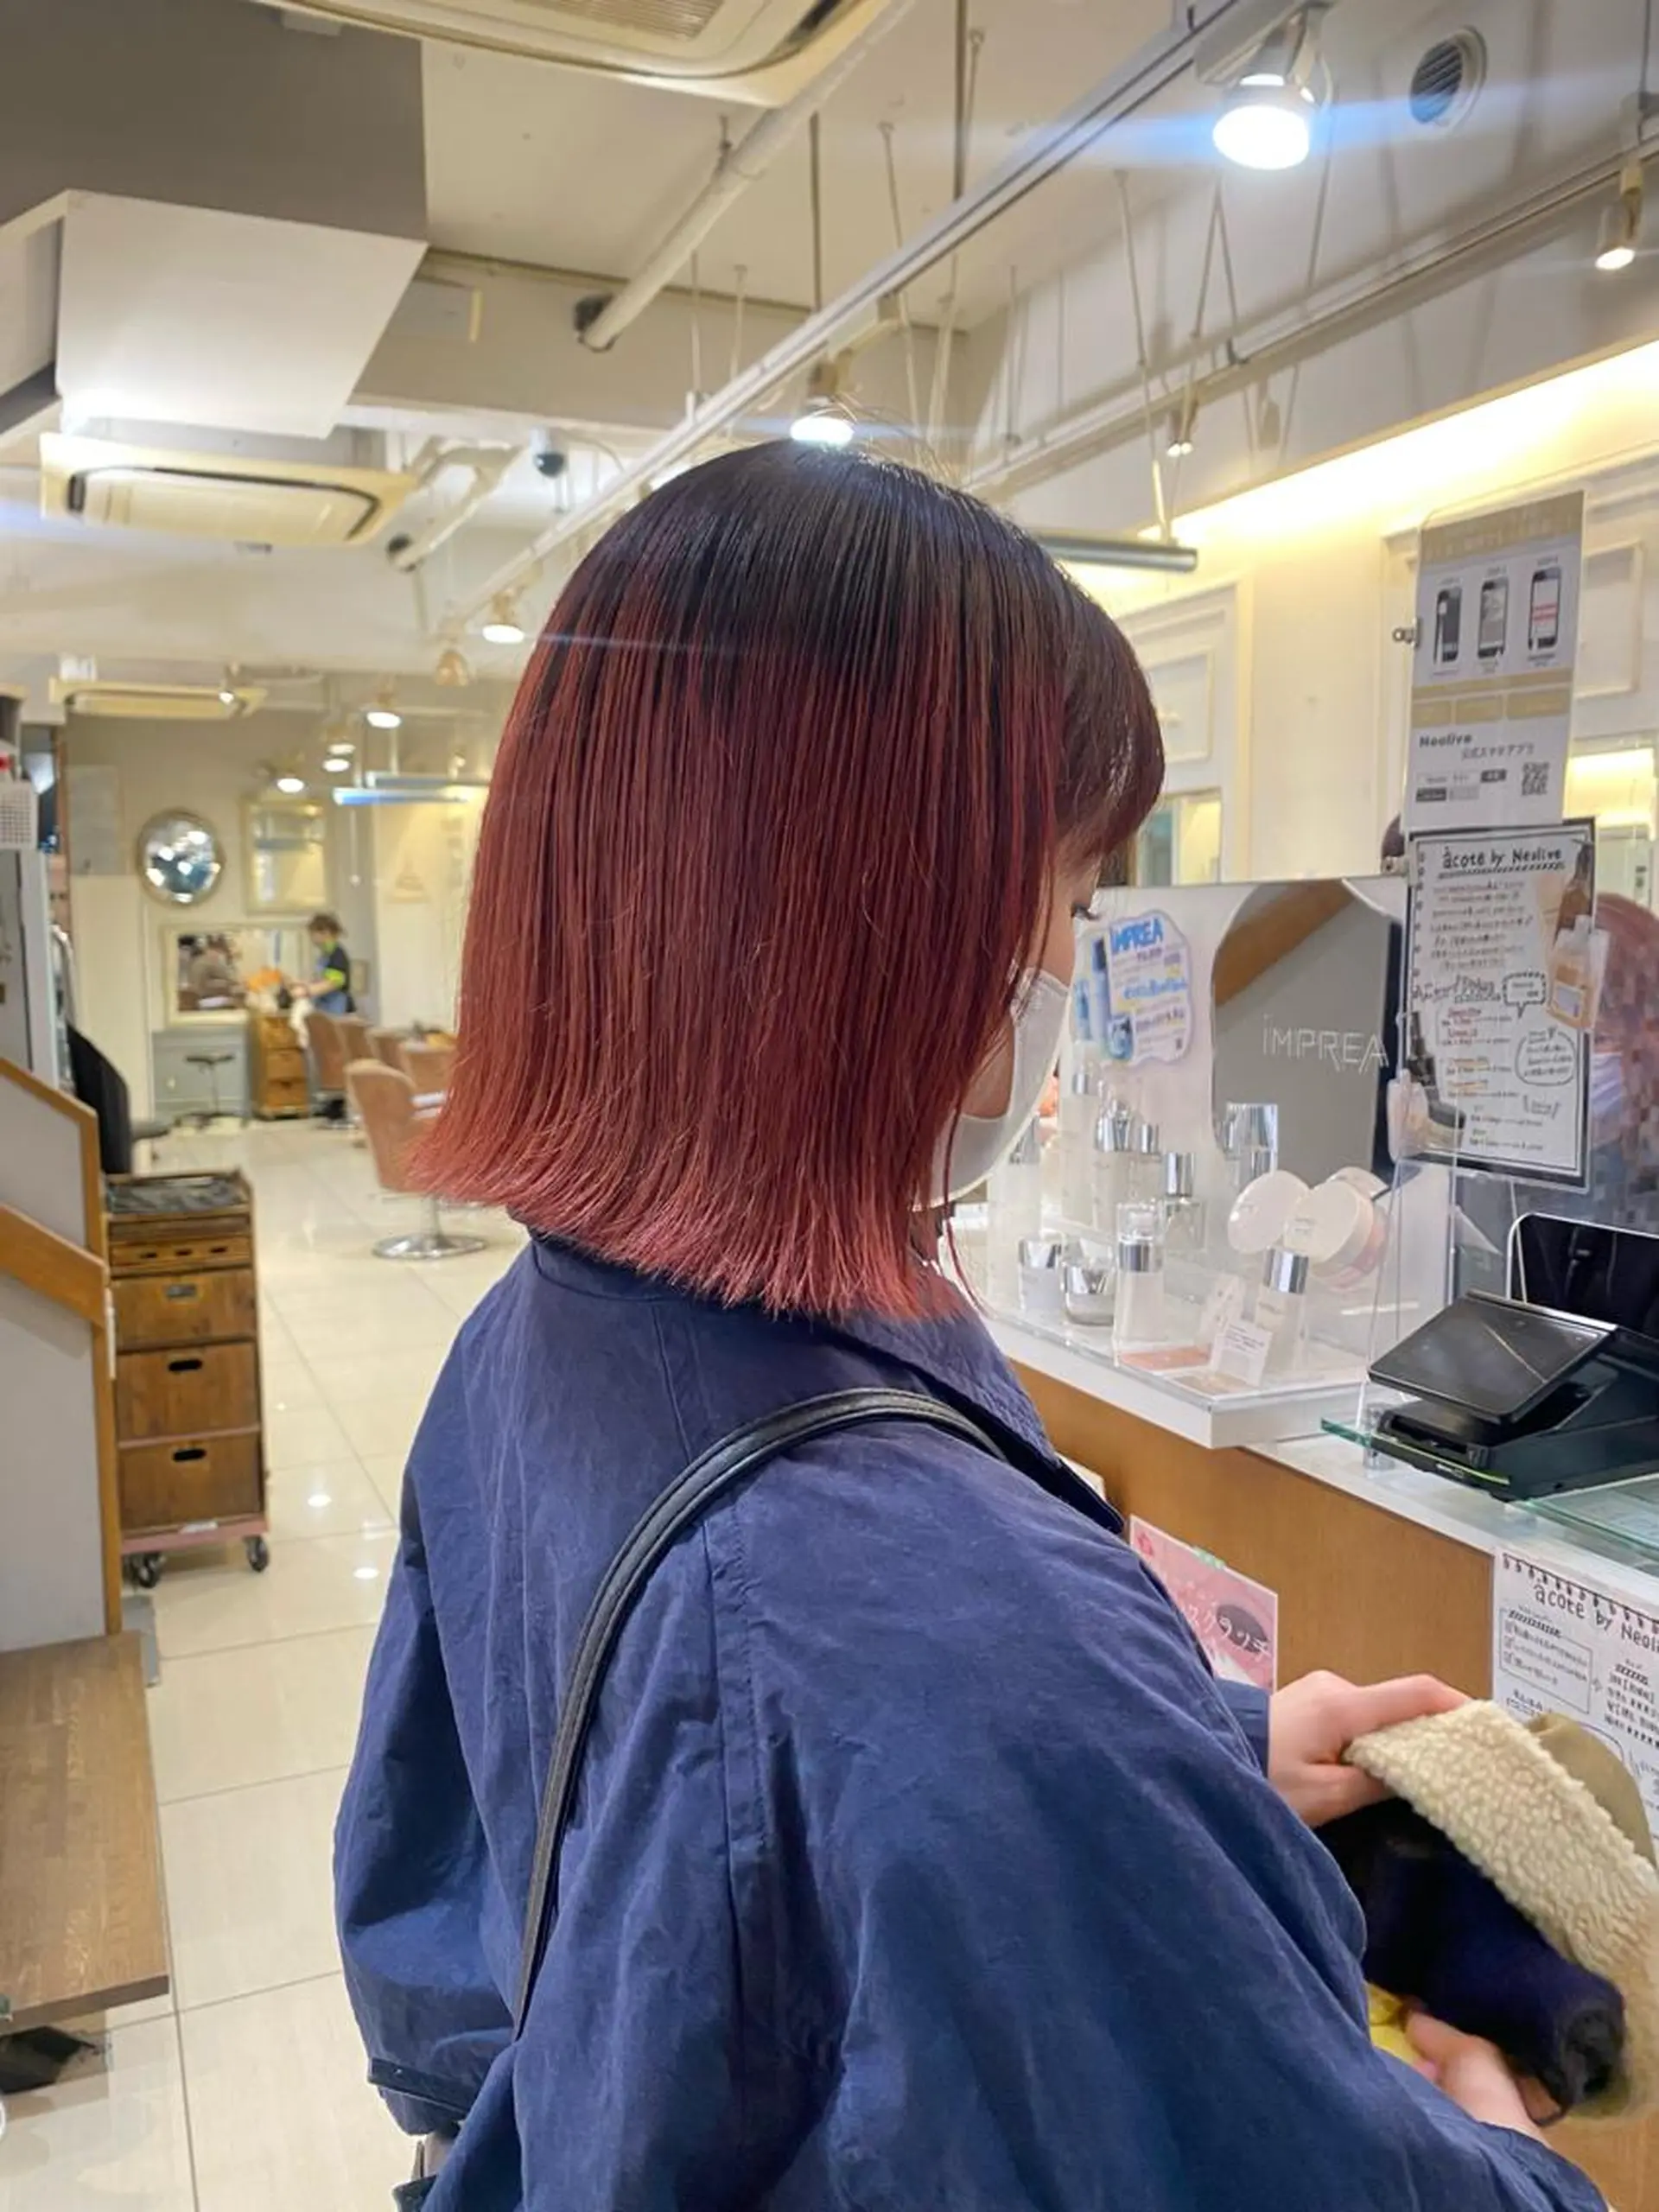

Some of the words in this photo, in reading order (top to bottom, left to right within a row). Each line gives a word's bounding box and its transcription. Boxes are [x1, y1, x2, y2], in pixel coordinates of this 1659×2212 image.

[1419, 734, 1472, 748] Neolive
[1491, 849, 1505, 868] by
[1512, 847, 1562, 863] Neolive
[1596, 1610, 1613, 1632] by
